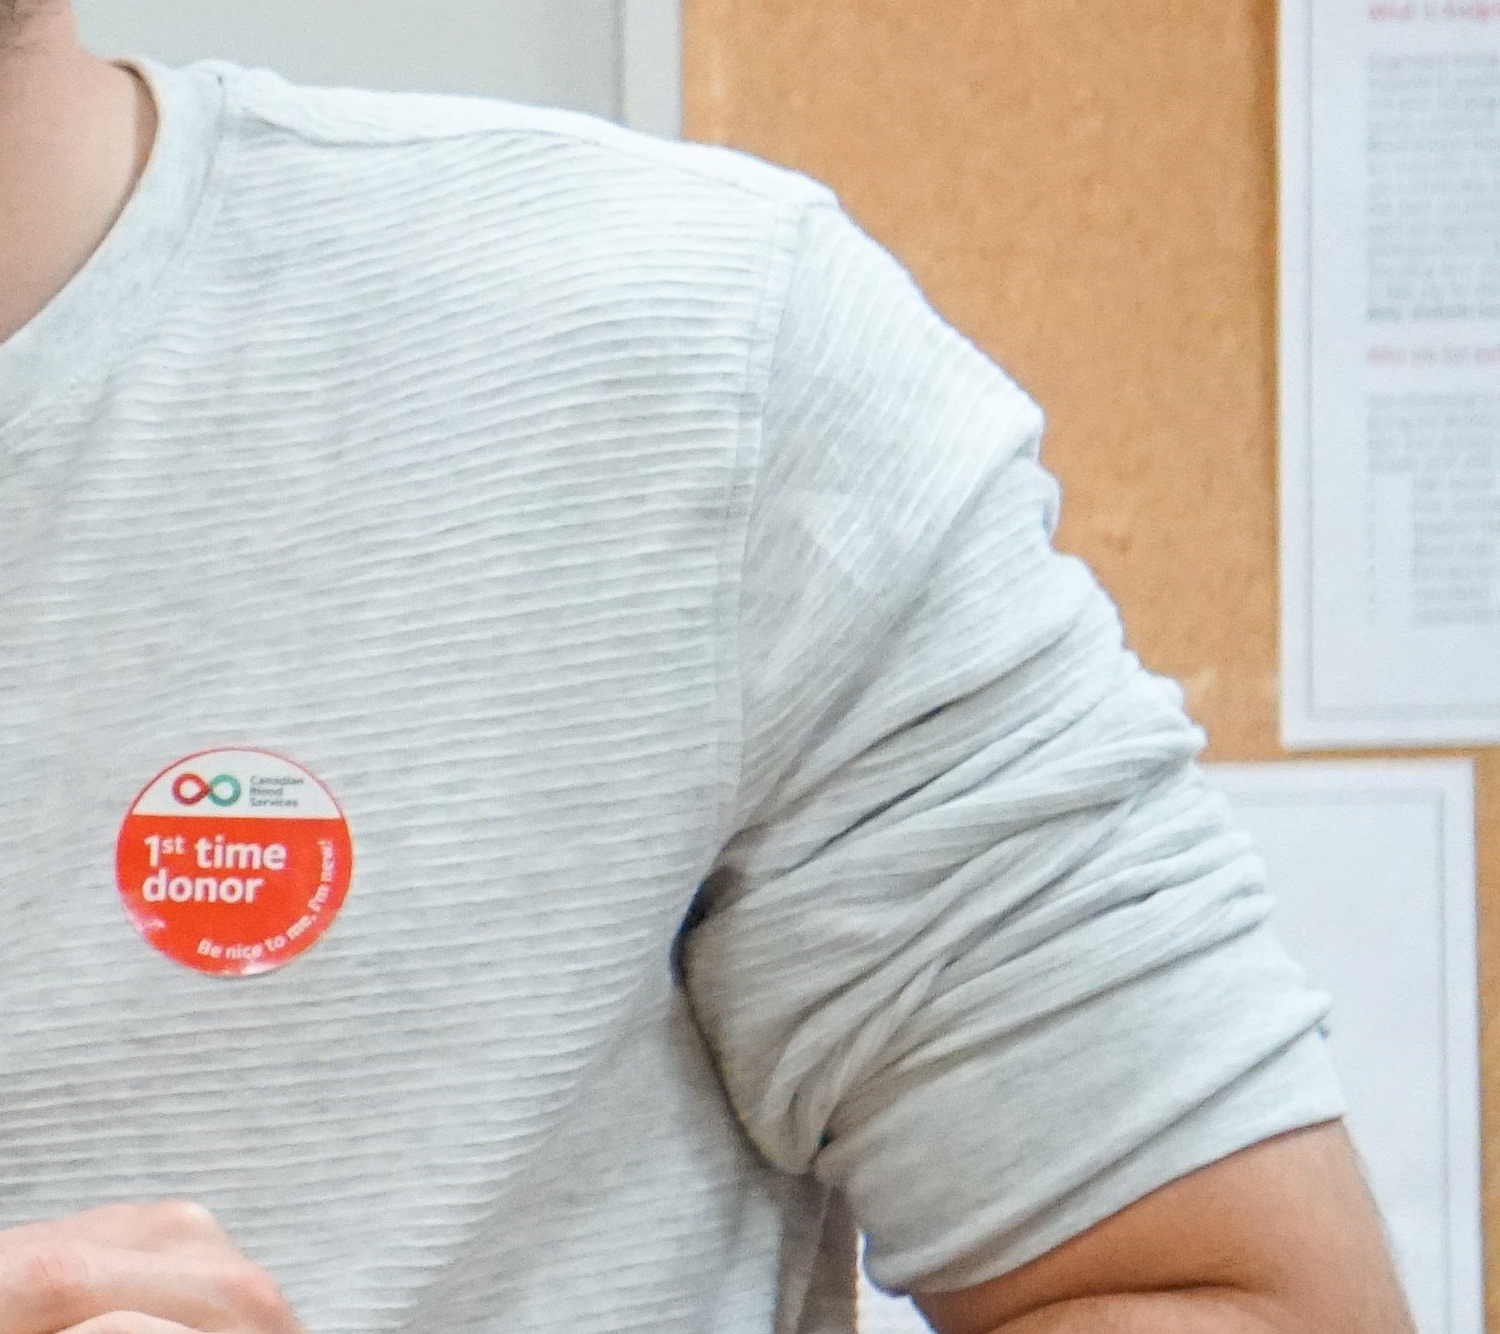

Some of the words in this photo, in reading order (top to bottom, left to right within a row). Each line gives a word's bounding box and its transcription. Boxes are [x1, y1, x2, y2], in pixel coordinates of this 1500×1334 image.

[144, 834, 186, 867] 1st
[195, 835, 288, 871] time
[142, 868, 265, 904] donor
